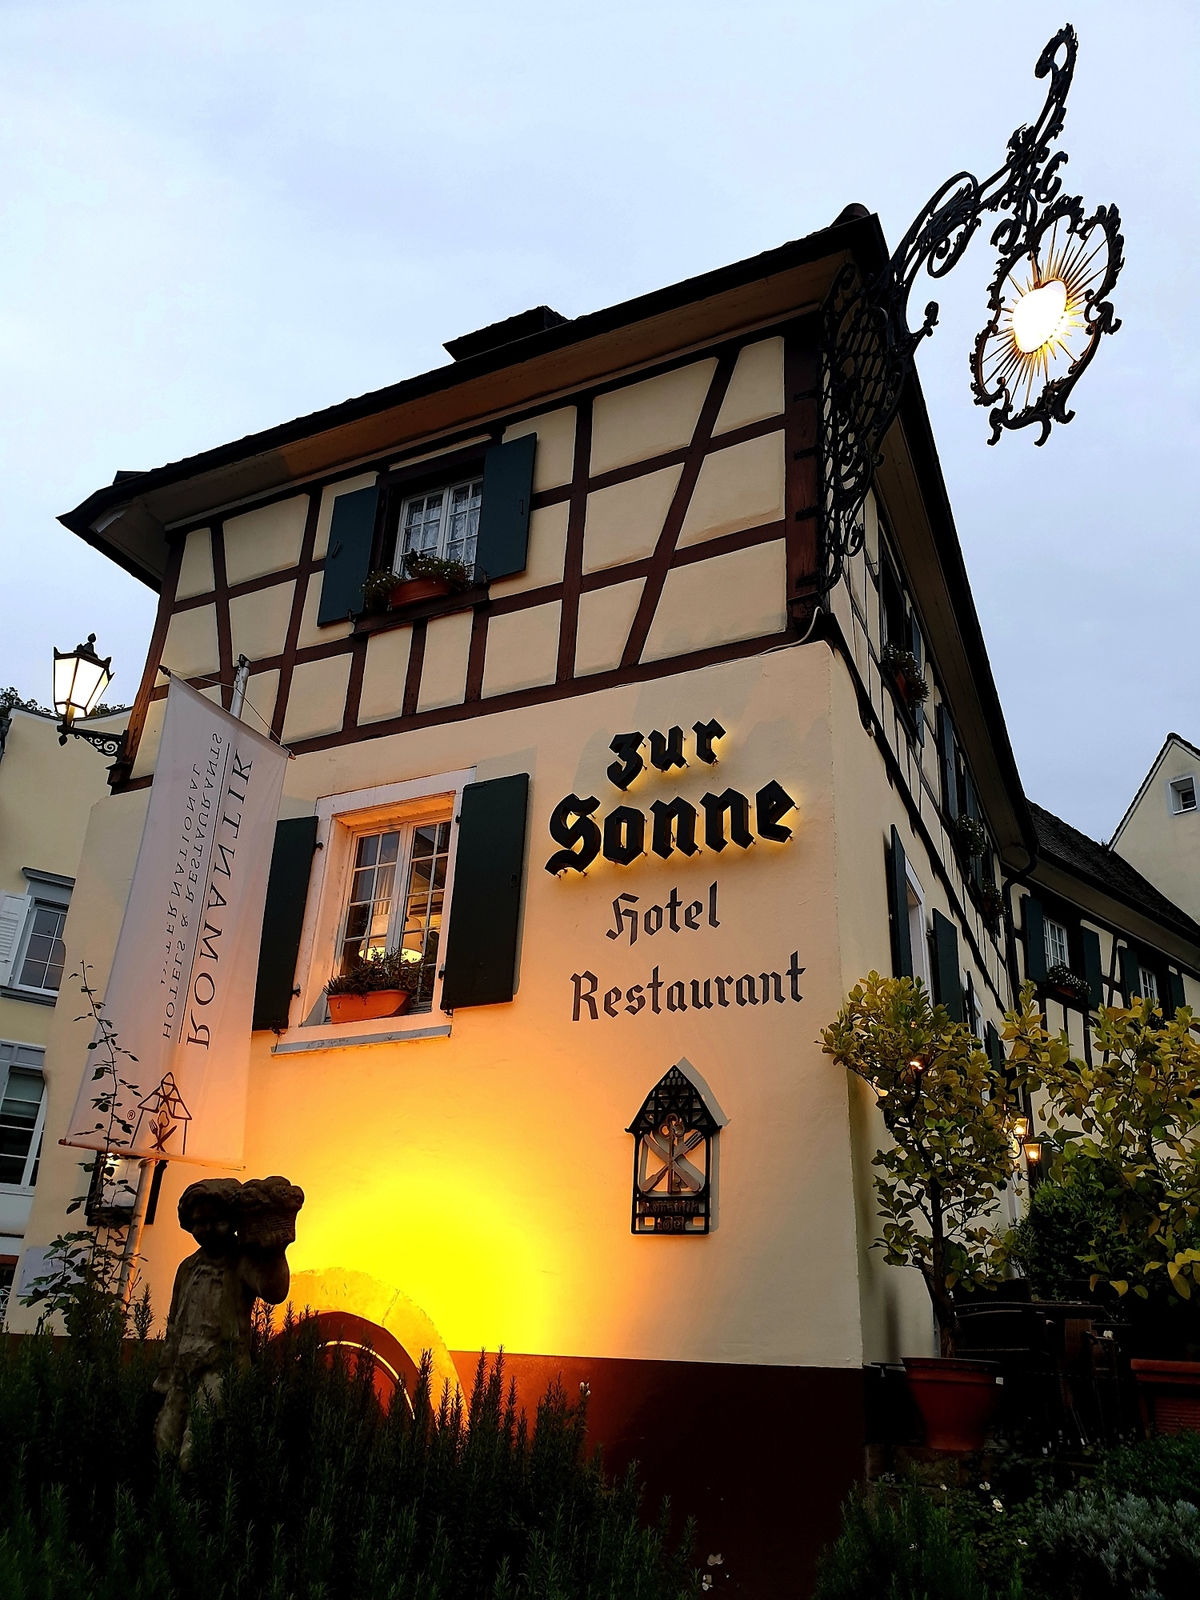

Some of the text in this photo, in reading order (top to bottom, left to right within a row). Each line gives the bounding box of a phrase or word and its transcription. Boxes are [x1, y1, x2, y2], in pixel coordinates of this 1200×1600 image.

[606, 717, 726, 791] zur
[545, 779, 796, 875] Sonne
[606, 881, 720, 946] Hotel
[570, 951, 806, 1022] Restaurant
